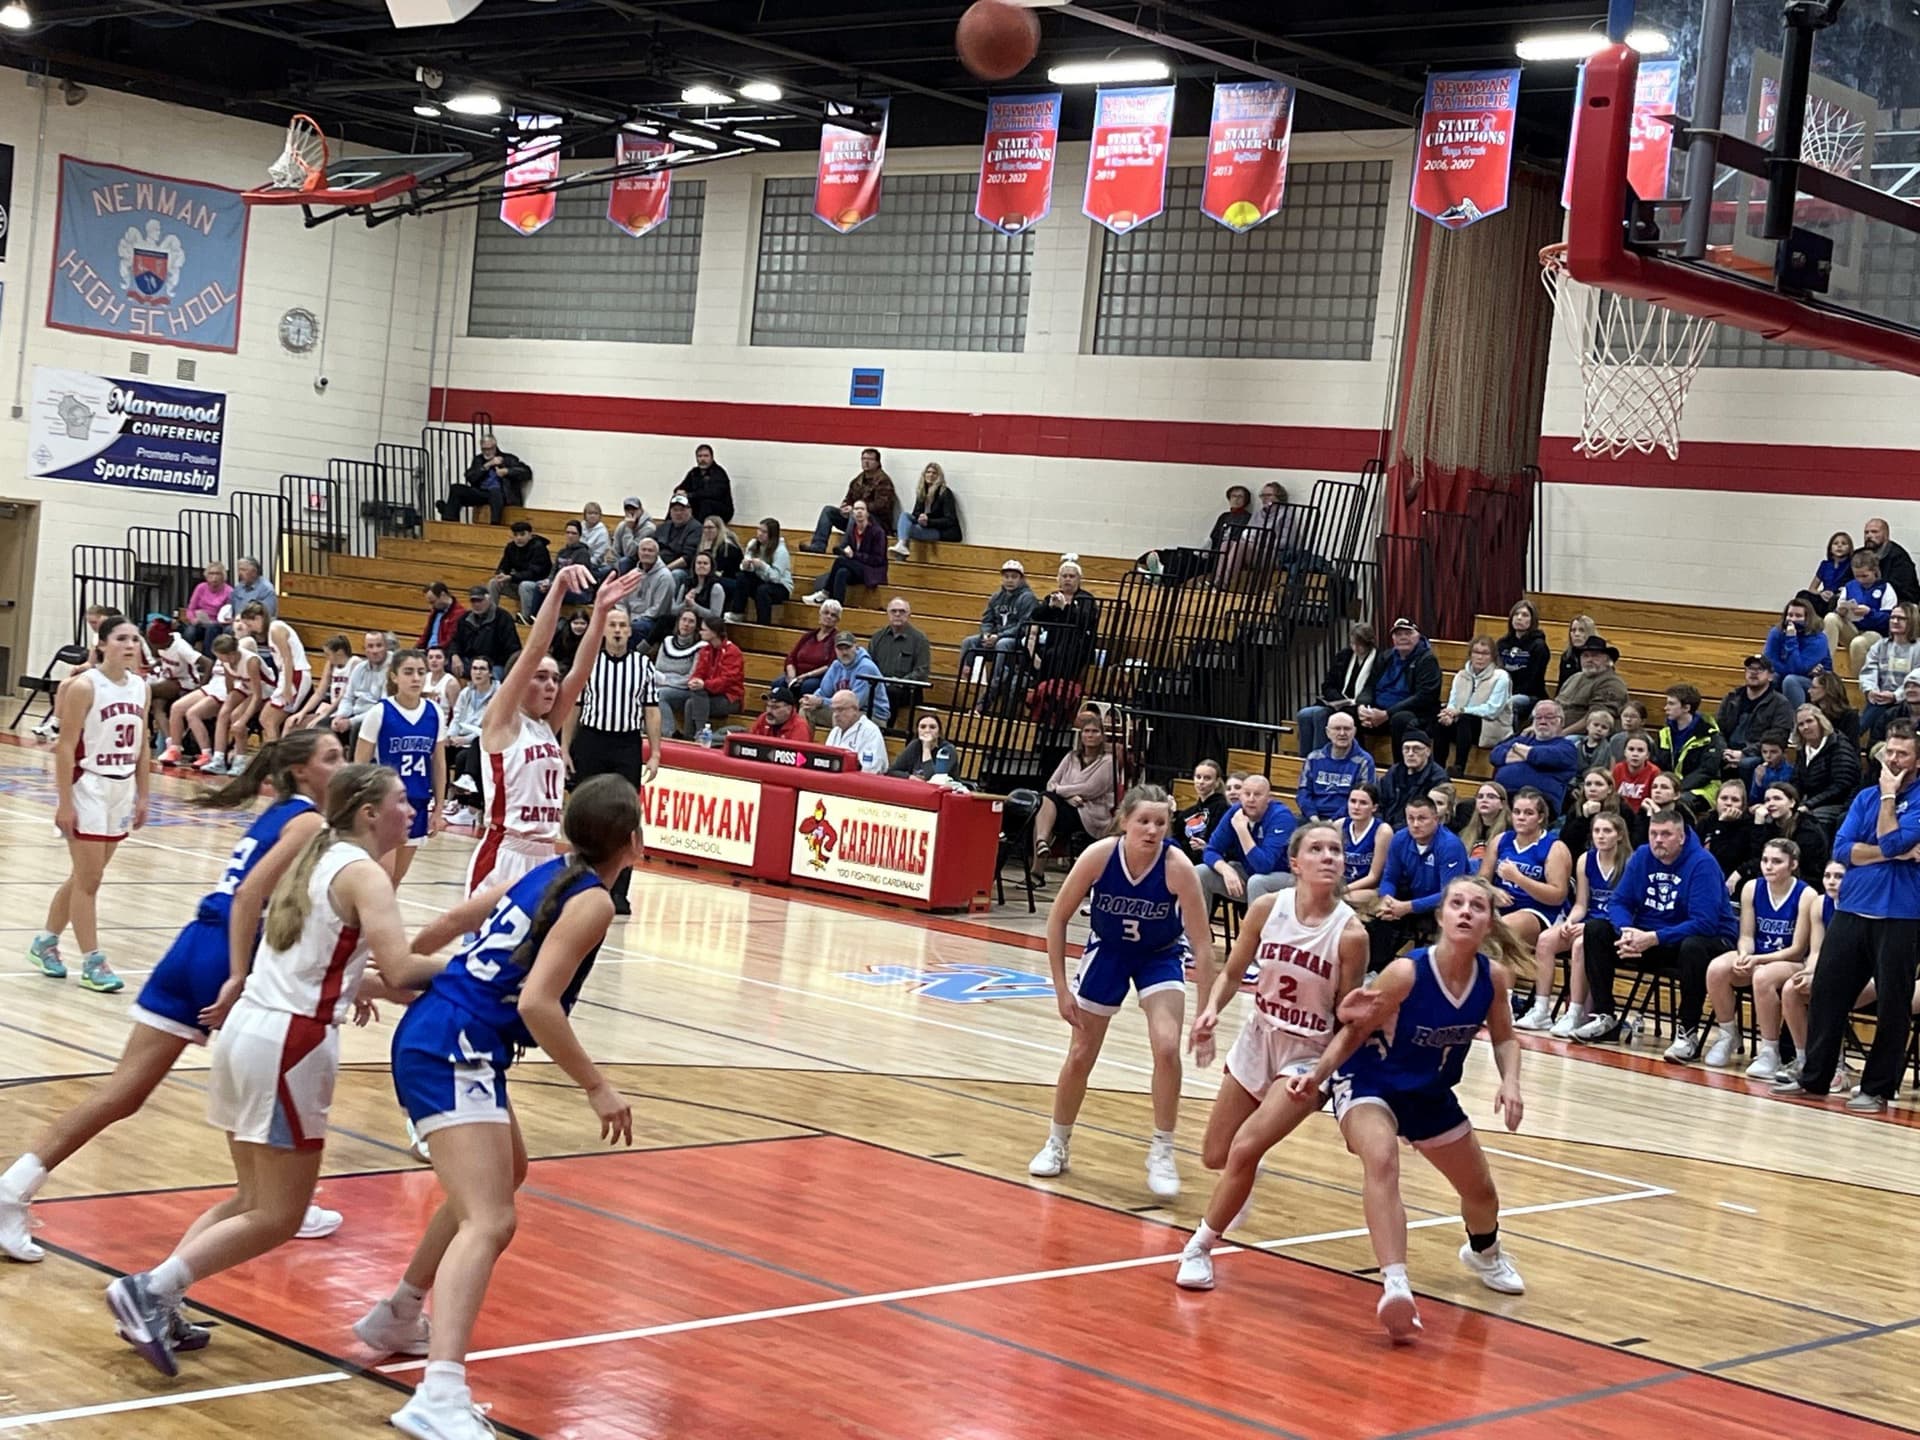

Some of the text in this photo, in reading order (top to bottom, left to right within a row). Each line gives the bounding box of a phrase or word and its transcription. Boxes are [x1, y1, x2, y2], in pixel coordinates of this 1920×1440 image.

[1432, 76, 1512, 95] NEWMAN
[992, 102, 1053, 117] NEWMAN
[1431, 93, 1510, 111] CATHOLIC
[1224, 127, 1259, 140] STATE
[1438, 118, 1480, 132] STATE
[997, 137, 1030, 150] STATE
[1425, 131, 1506, 147] CHAMPIONS
[987, 148, 1052, 163] CHAMPIONS
[1424, 158, 1476, 171] 2006, 2007
[92, 183, 217, 235] NEWMAN
[59, 249, 237, 336] HIGH SCHOOL
[106, 386, 222, 424] Marawood
[132, 422, 221, 444] CONFERENCE
[136, 447, 180, 462] Promotes
[94, 458, 216, 490] Sportsmanship
[115, 724, 135, 748] 30
[400, 754, 426, 777] 24
[774, 750, 796, 765] POSS
[545, 769, 558, 799] 11
[640, 784, 754, 843] NEWMAN
[660, 834, 722, 855] HIGH SCHOOL
[838, 818, 929, 876] CARDINALS
[1097, 894, 1170, 920] ROYALS
[1122, 919, 1141, 942] 3
[1279, 975, 1298, 1003] 2
